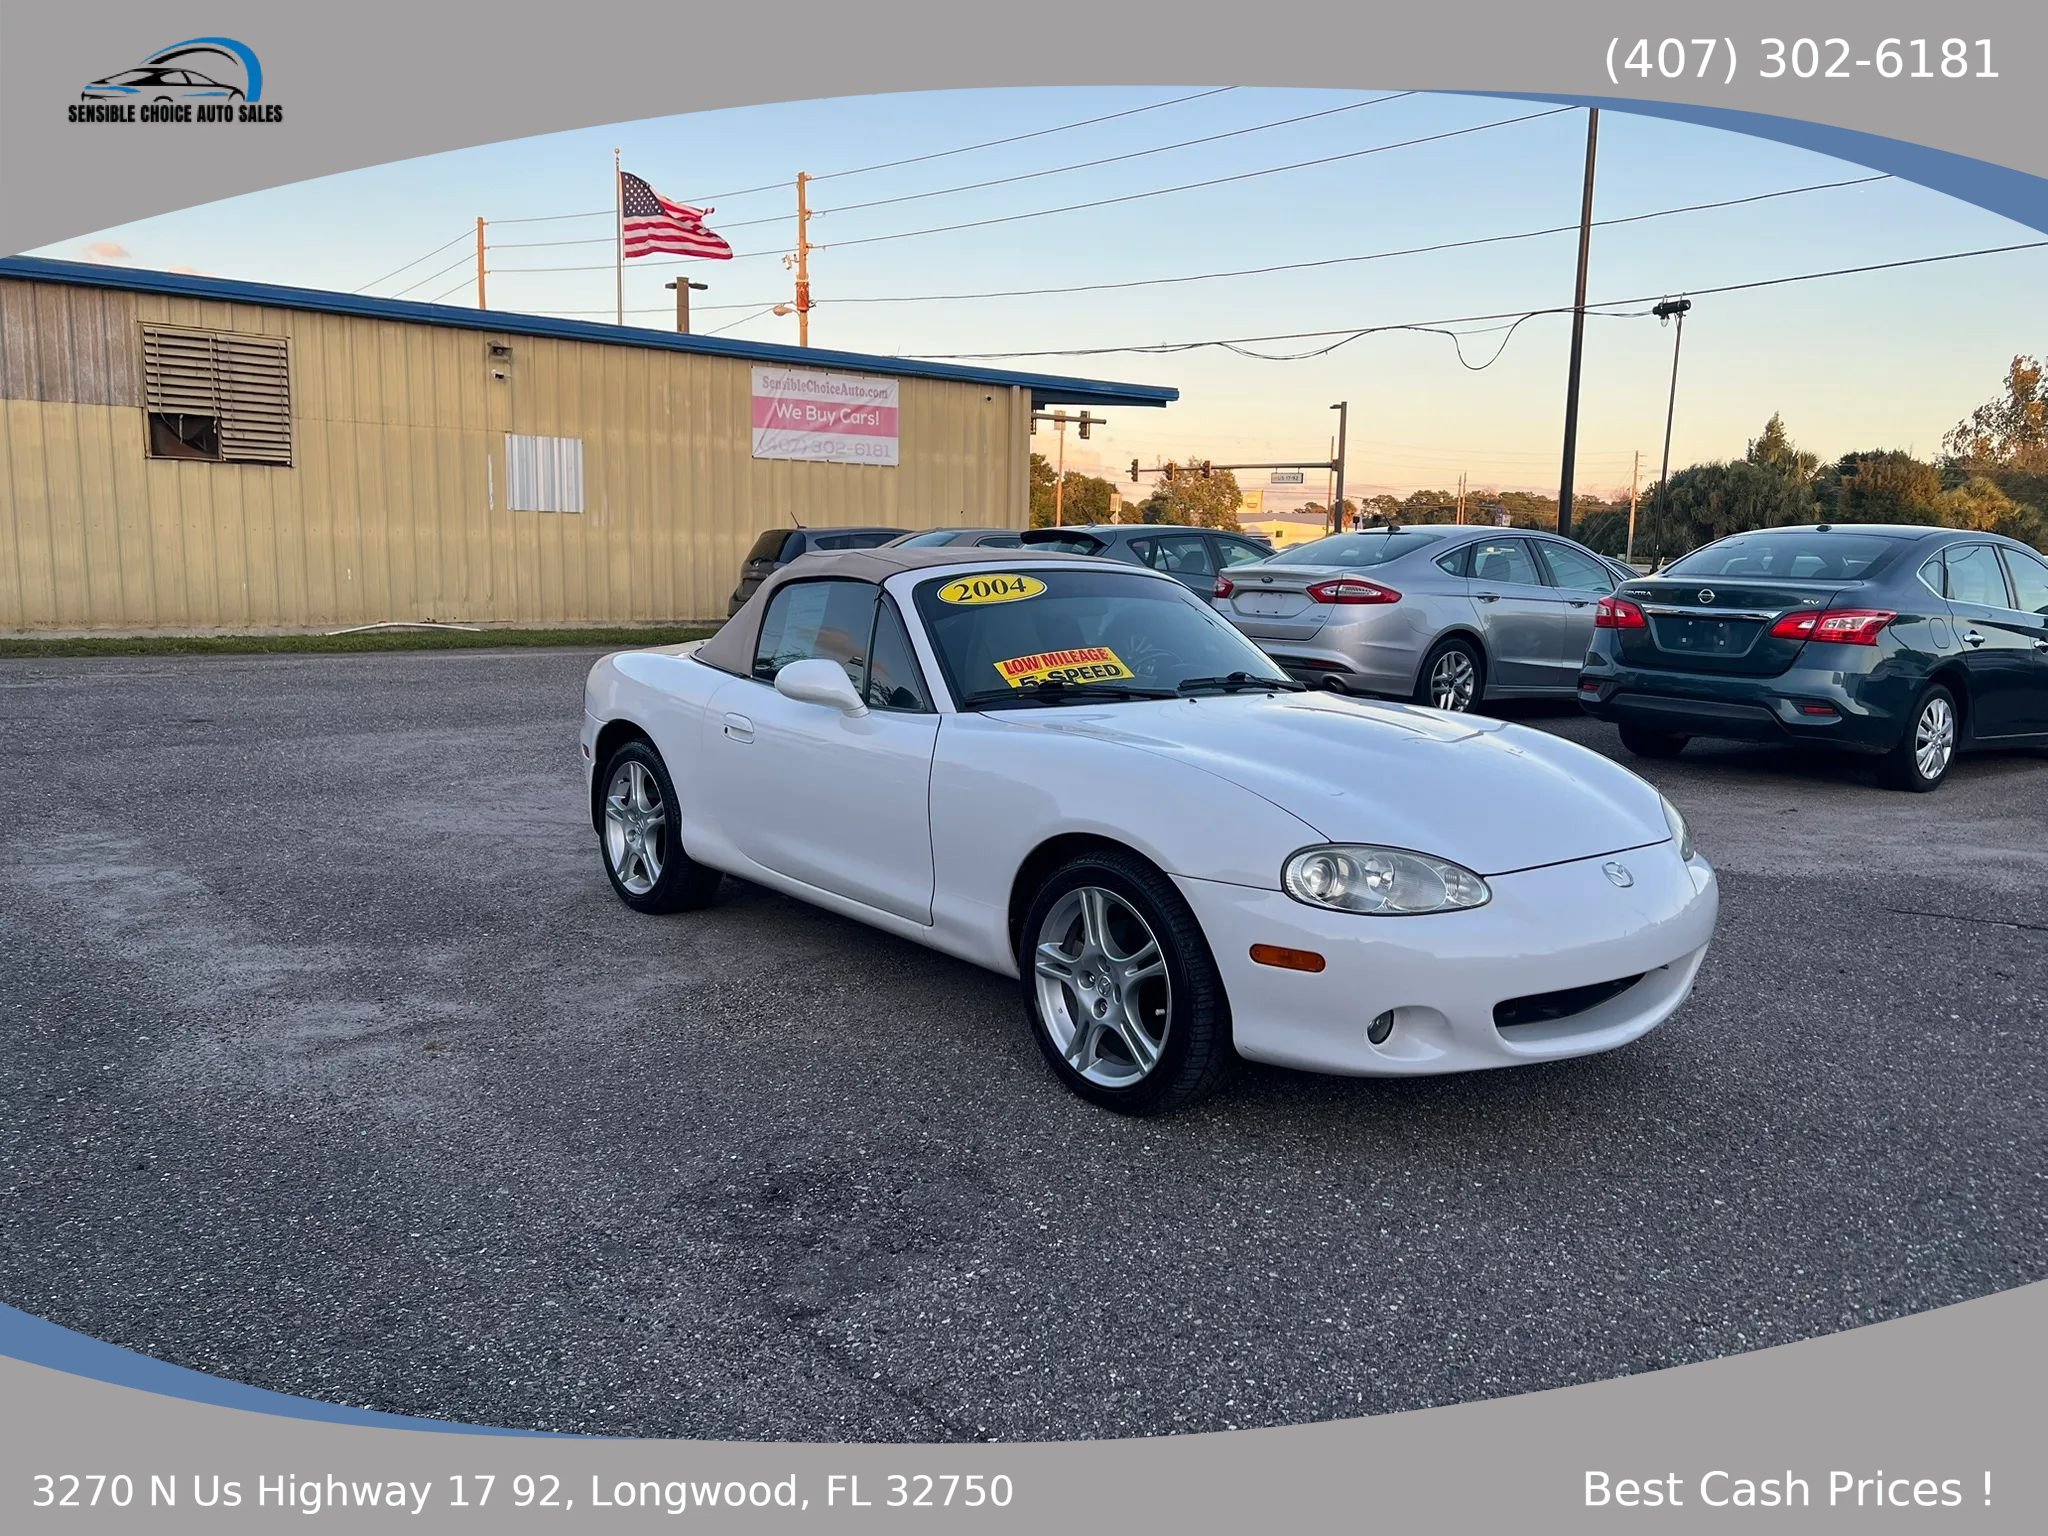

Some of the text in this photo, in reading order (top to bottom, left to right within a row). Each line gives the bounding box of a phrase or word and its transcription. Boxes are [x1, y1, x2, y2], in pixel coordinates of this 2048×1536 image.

[762, 375, 889, 400] SensibleChoiceAuto.com
[774, 402, 880, 426] We Buy Cars!
[811, 440, 890, 458] 302-6181
[953, 576, 1027, 602] 2004
[1002, 647, 1110, 676] LOW MILEAGE
[1018, 663, 1123, 688] 5-SPEED
